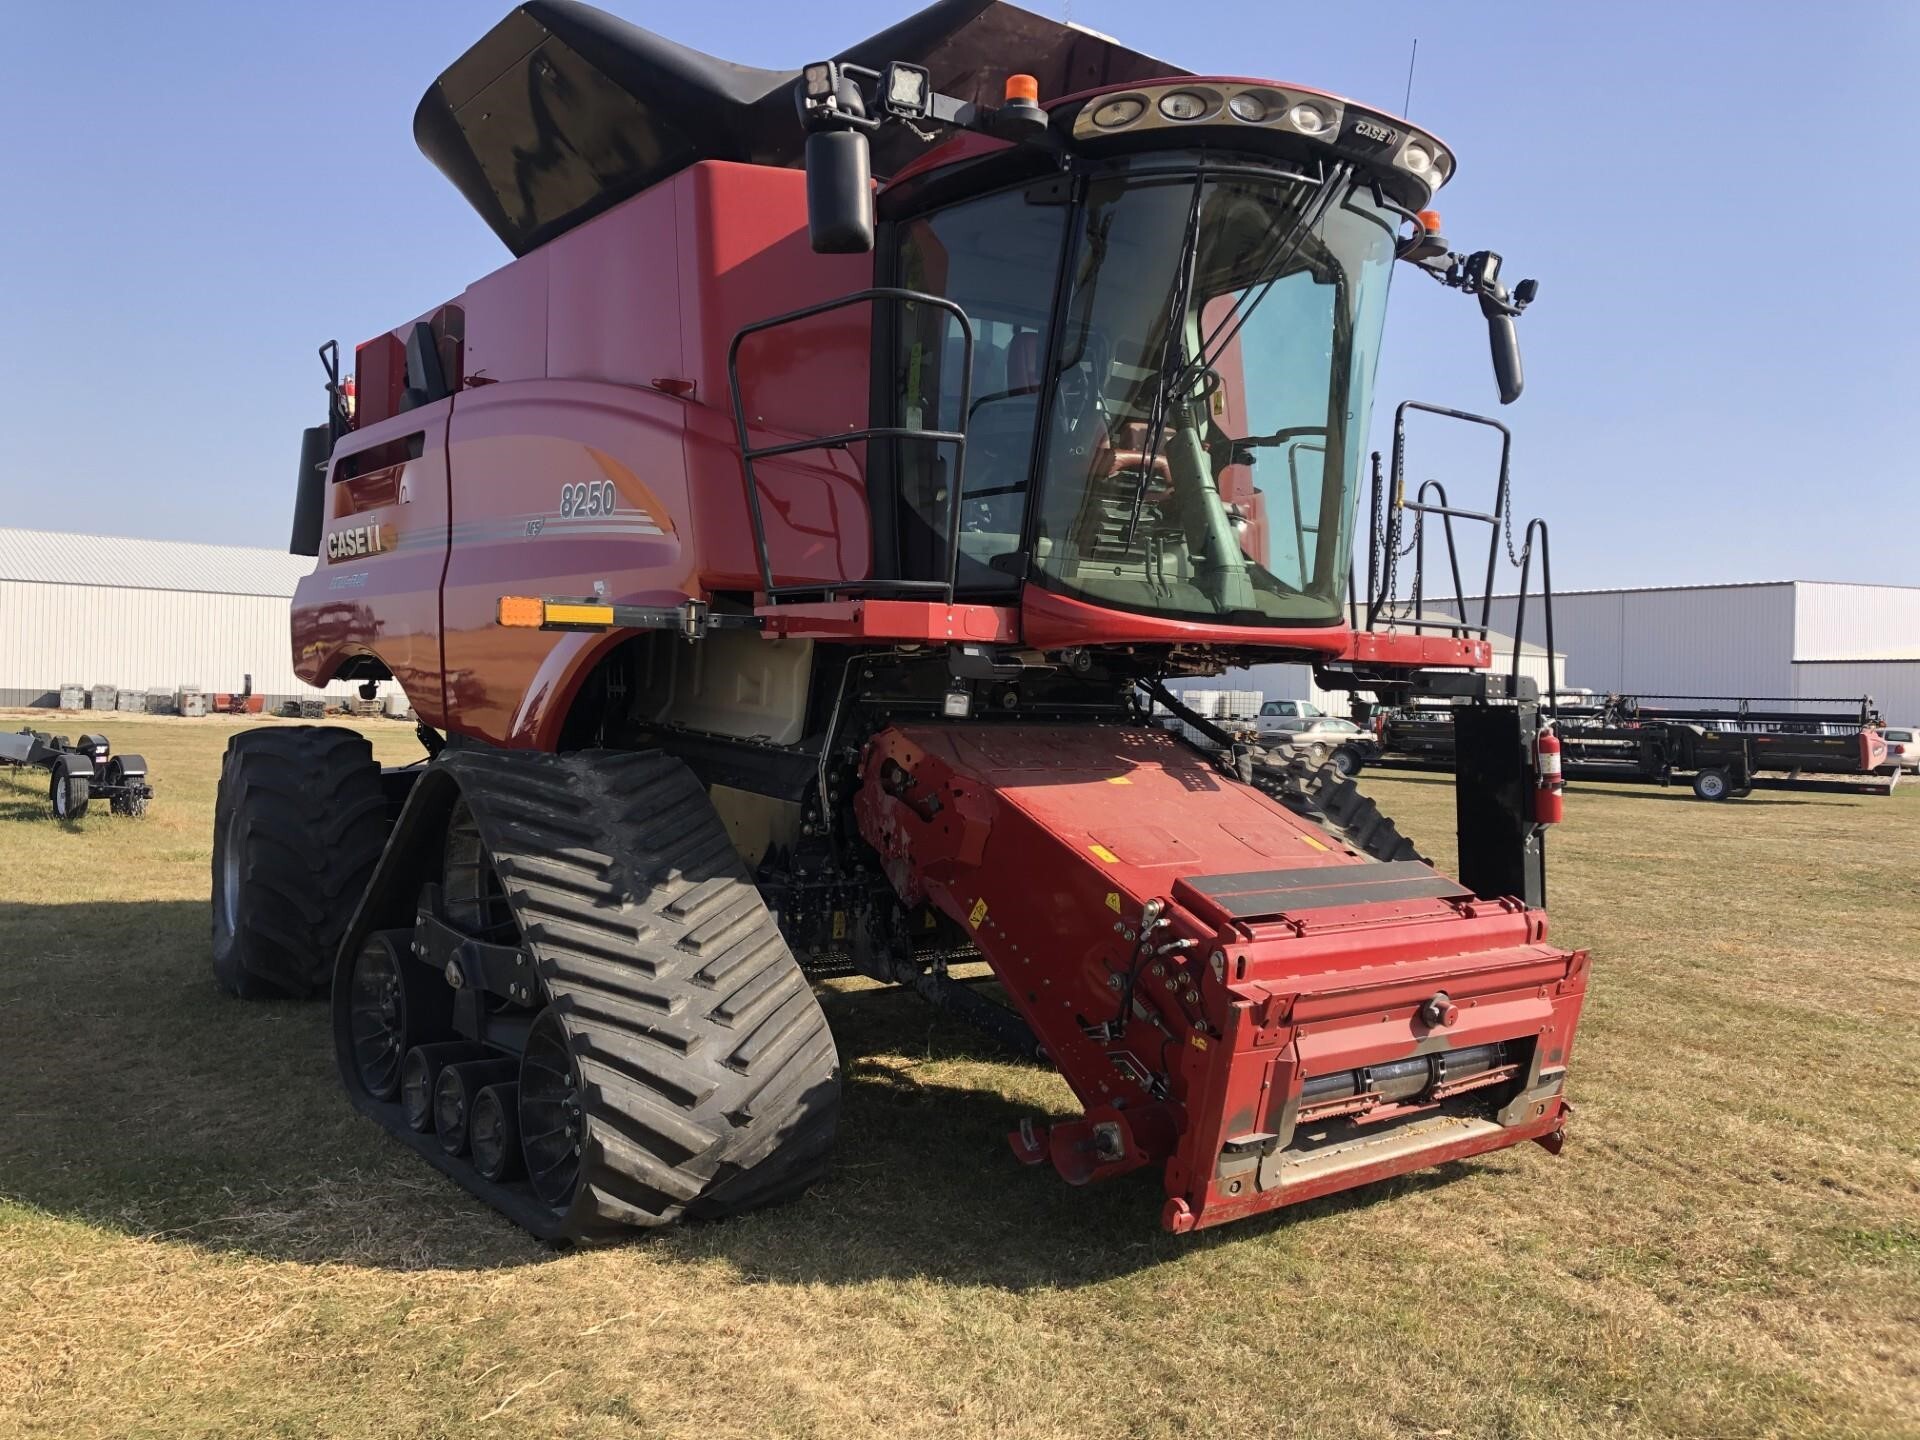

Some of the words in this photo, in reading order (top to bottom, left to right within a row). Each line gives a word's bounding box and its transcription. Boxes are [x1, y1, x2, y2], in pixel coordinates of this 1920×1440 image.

[1355, 121, 1388, 142] CASE
[560, 480, 616, 519] 8250
[328, 527, 367, 559] CASE
